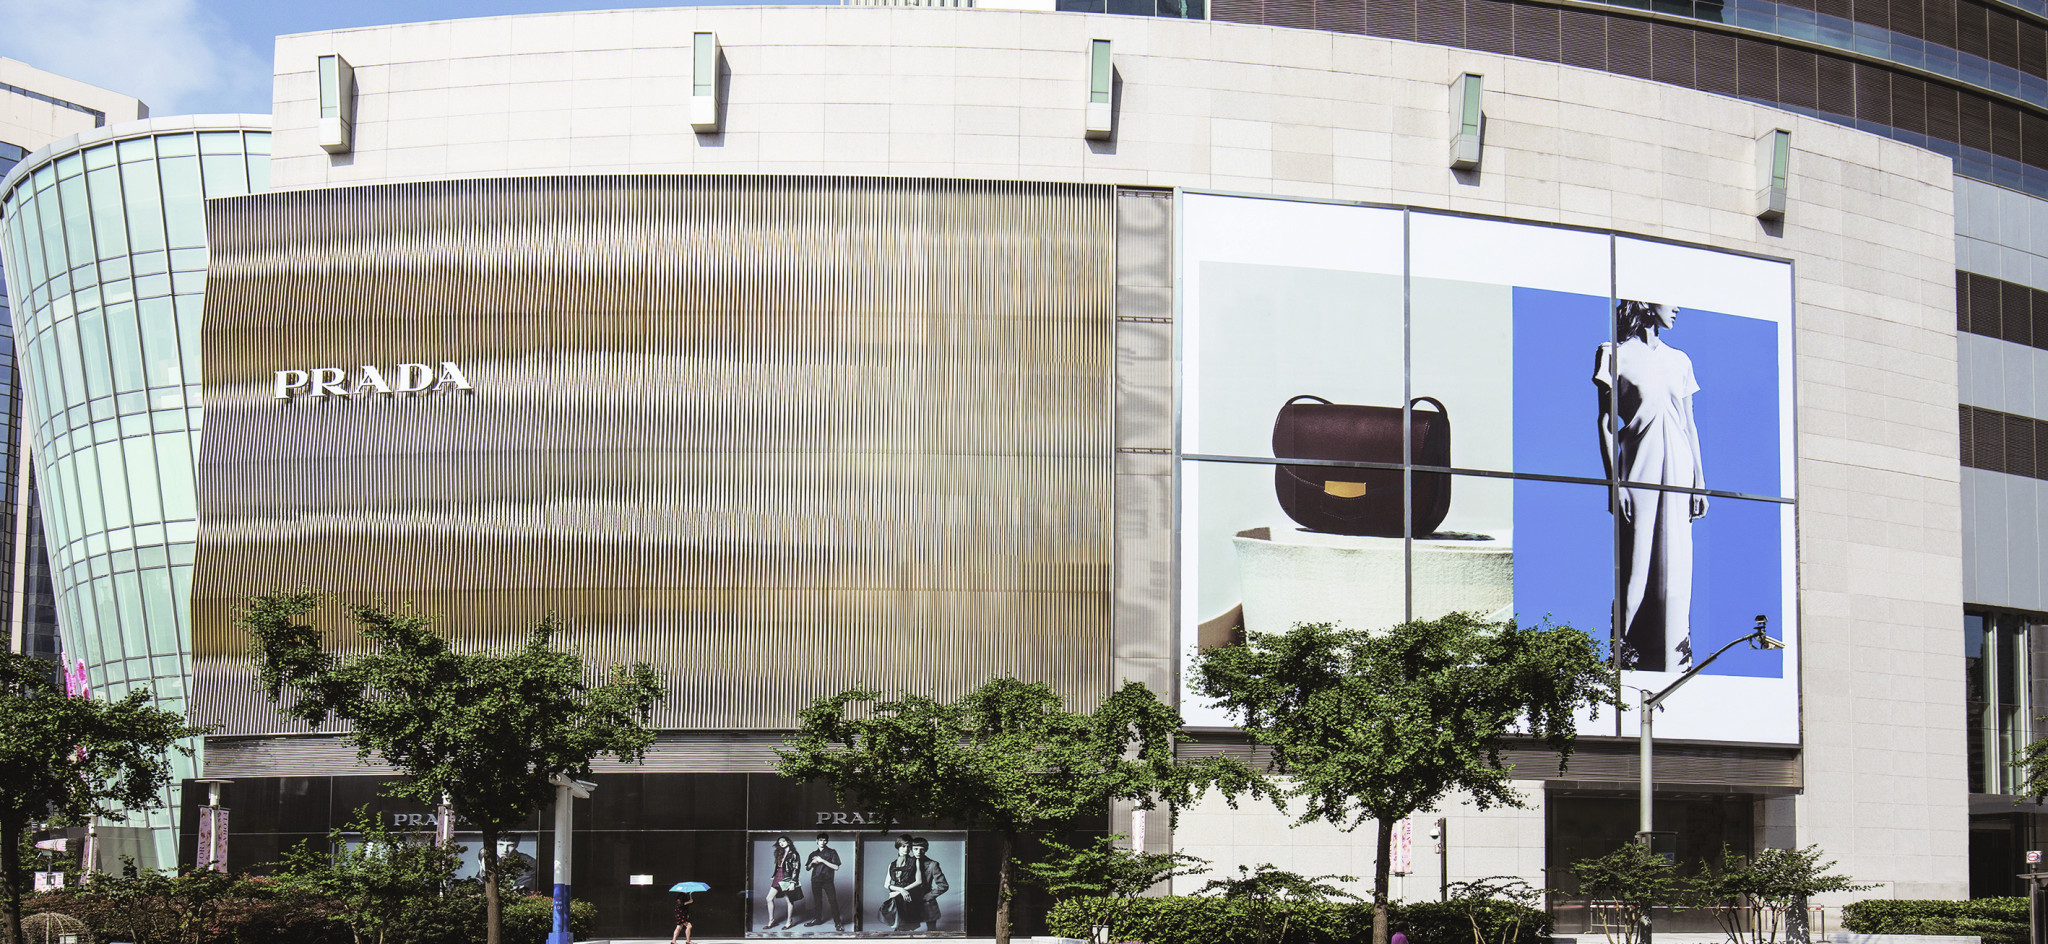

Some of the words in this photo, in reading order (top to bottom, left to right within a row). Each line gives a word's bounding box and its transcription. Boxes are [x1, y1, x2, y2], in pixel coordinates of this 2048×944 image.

[273, 361, 473, 400] PRADA
[393, 813, 472, 826] PRA
[198, 841, 206, 869] LORA
